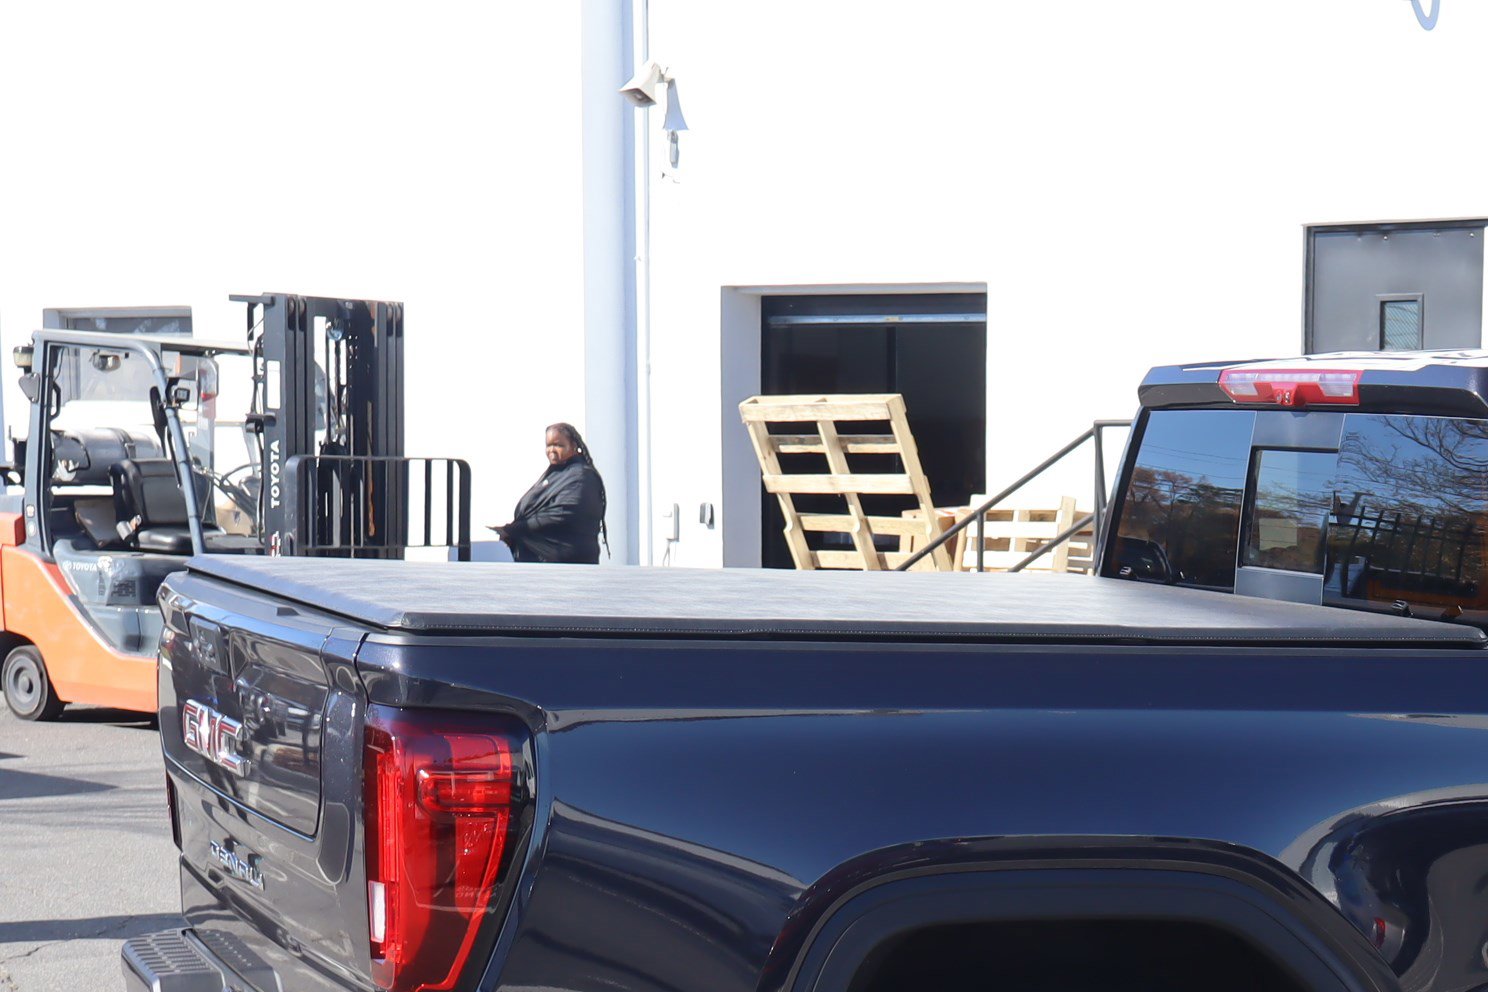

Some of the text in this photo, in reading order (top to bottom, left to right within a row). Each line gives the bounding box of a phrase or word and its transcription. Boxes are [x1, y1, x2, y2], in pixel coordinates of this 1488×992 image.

[271, 439, 281, 509] TOYOTA
[72, 561, 98, 572] TOYOTA
[183, 699, 252, 778] GMC
[210, 839, 265, 893] DENALI
